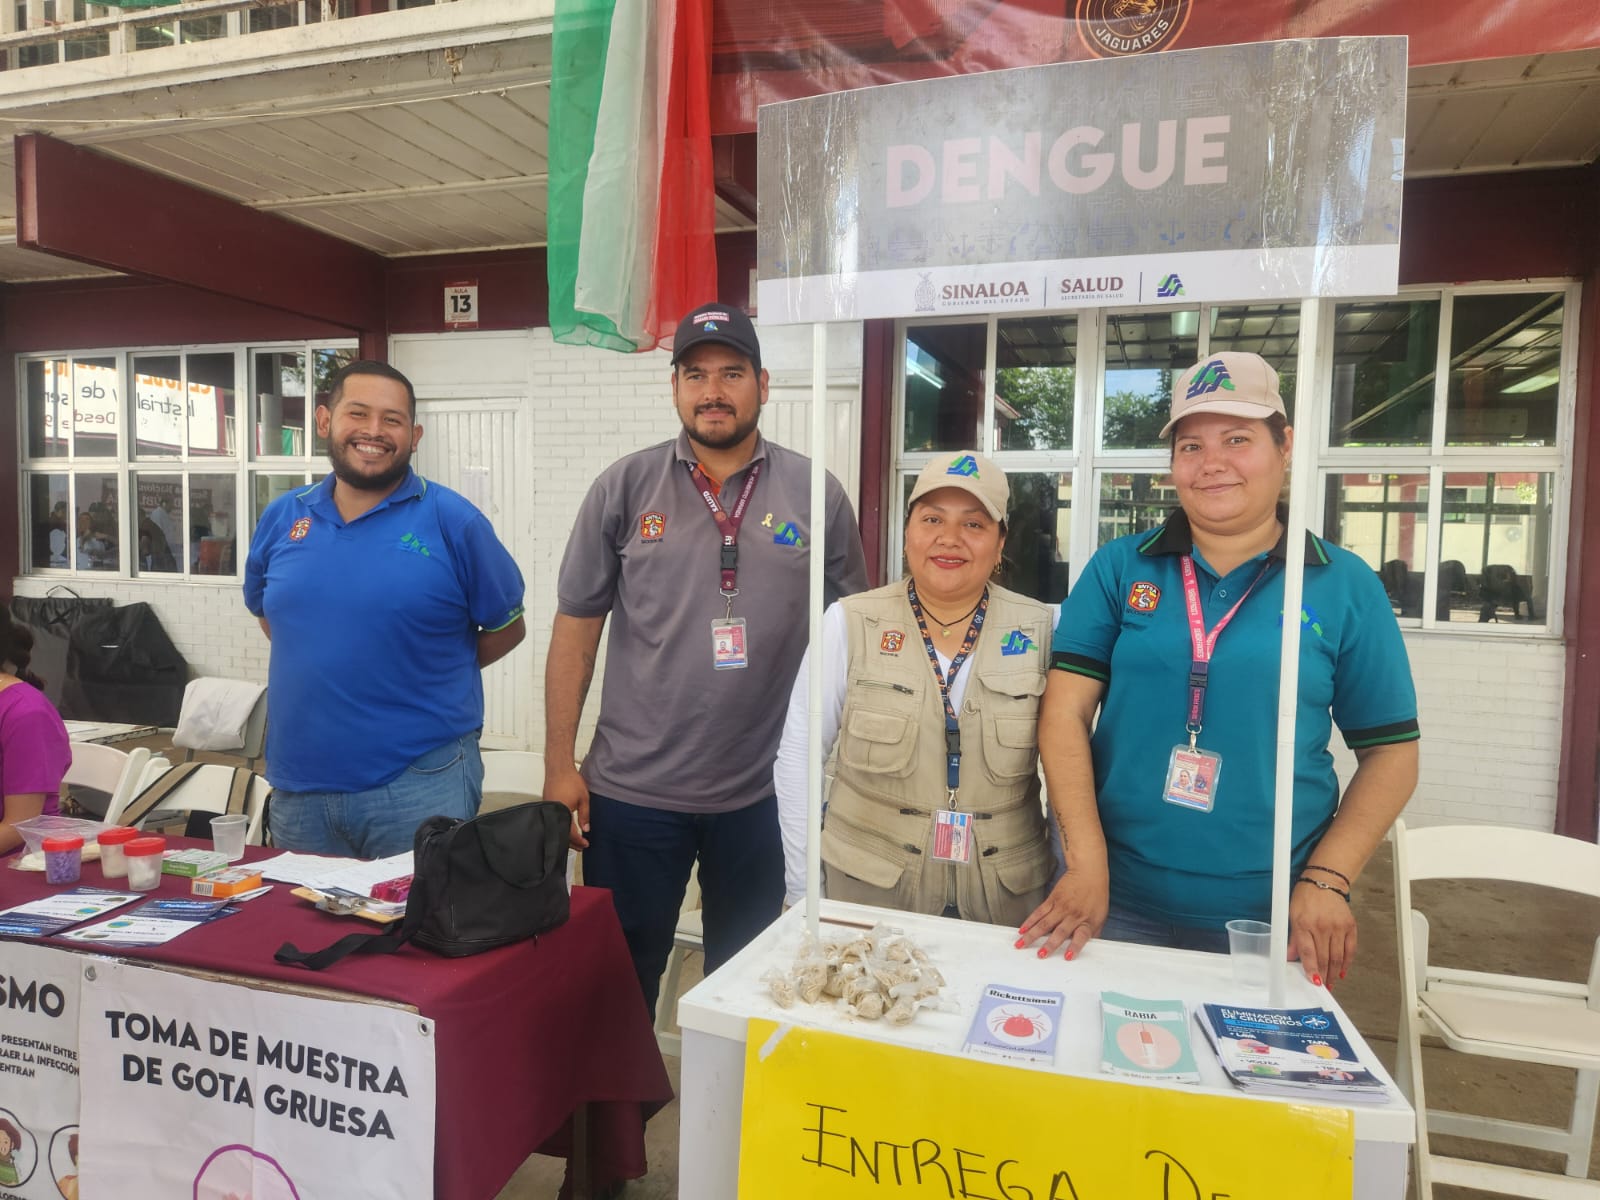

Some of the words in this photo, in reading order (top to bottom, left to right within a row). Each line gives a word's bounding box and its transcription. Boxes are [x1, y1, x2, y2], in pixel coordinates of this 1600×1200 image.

[1096, 19, 1169, 51] JAGUARES
[885, 115, 1231, 208] DENGUE
[942, 280, 1029, 299] SINALOA
[1061, 277, 1124, 293] SALUD
[451, 295, 471, 312] 13
[703, 491, 719, 512] SALUD
[989, 989, 1057, 1005] Rickettsiosis
[1124, 1009, 1158, 1020] RABIA
[1221, 1008, 1292, 1021] ELIMINACIÓN
[1223, 1012, 1238, 1020] DE
[1240, 1014, 1303, 1027] CRIADEROS
[1, 1034, 52, 1052] PRESENTAN
[53, 1045, 78, 1060] ENTRE
[105, 1011, 200, 1051] TOMA
[208, 1027, 248, 1061] DE
[257, 1035, 409, 1098] MUESTRA
[23, 1052, 34, 1063] LA
[36, 1055, 80, 1077] INFECCIÓN
[122, 1053, 163, 1086] DE
[171, 1063, 255, 1109] GOTA
[264, 1084, 395, 1140] GRUESA
[802, 1102, 1079, 1200] ENTREGA
[1145, 1150, 1230, 1200] D
